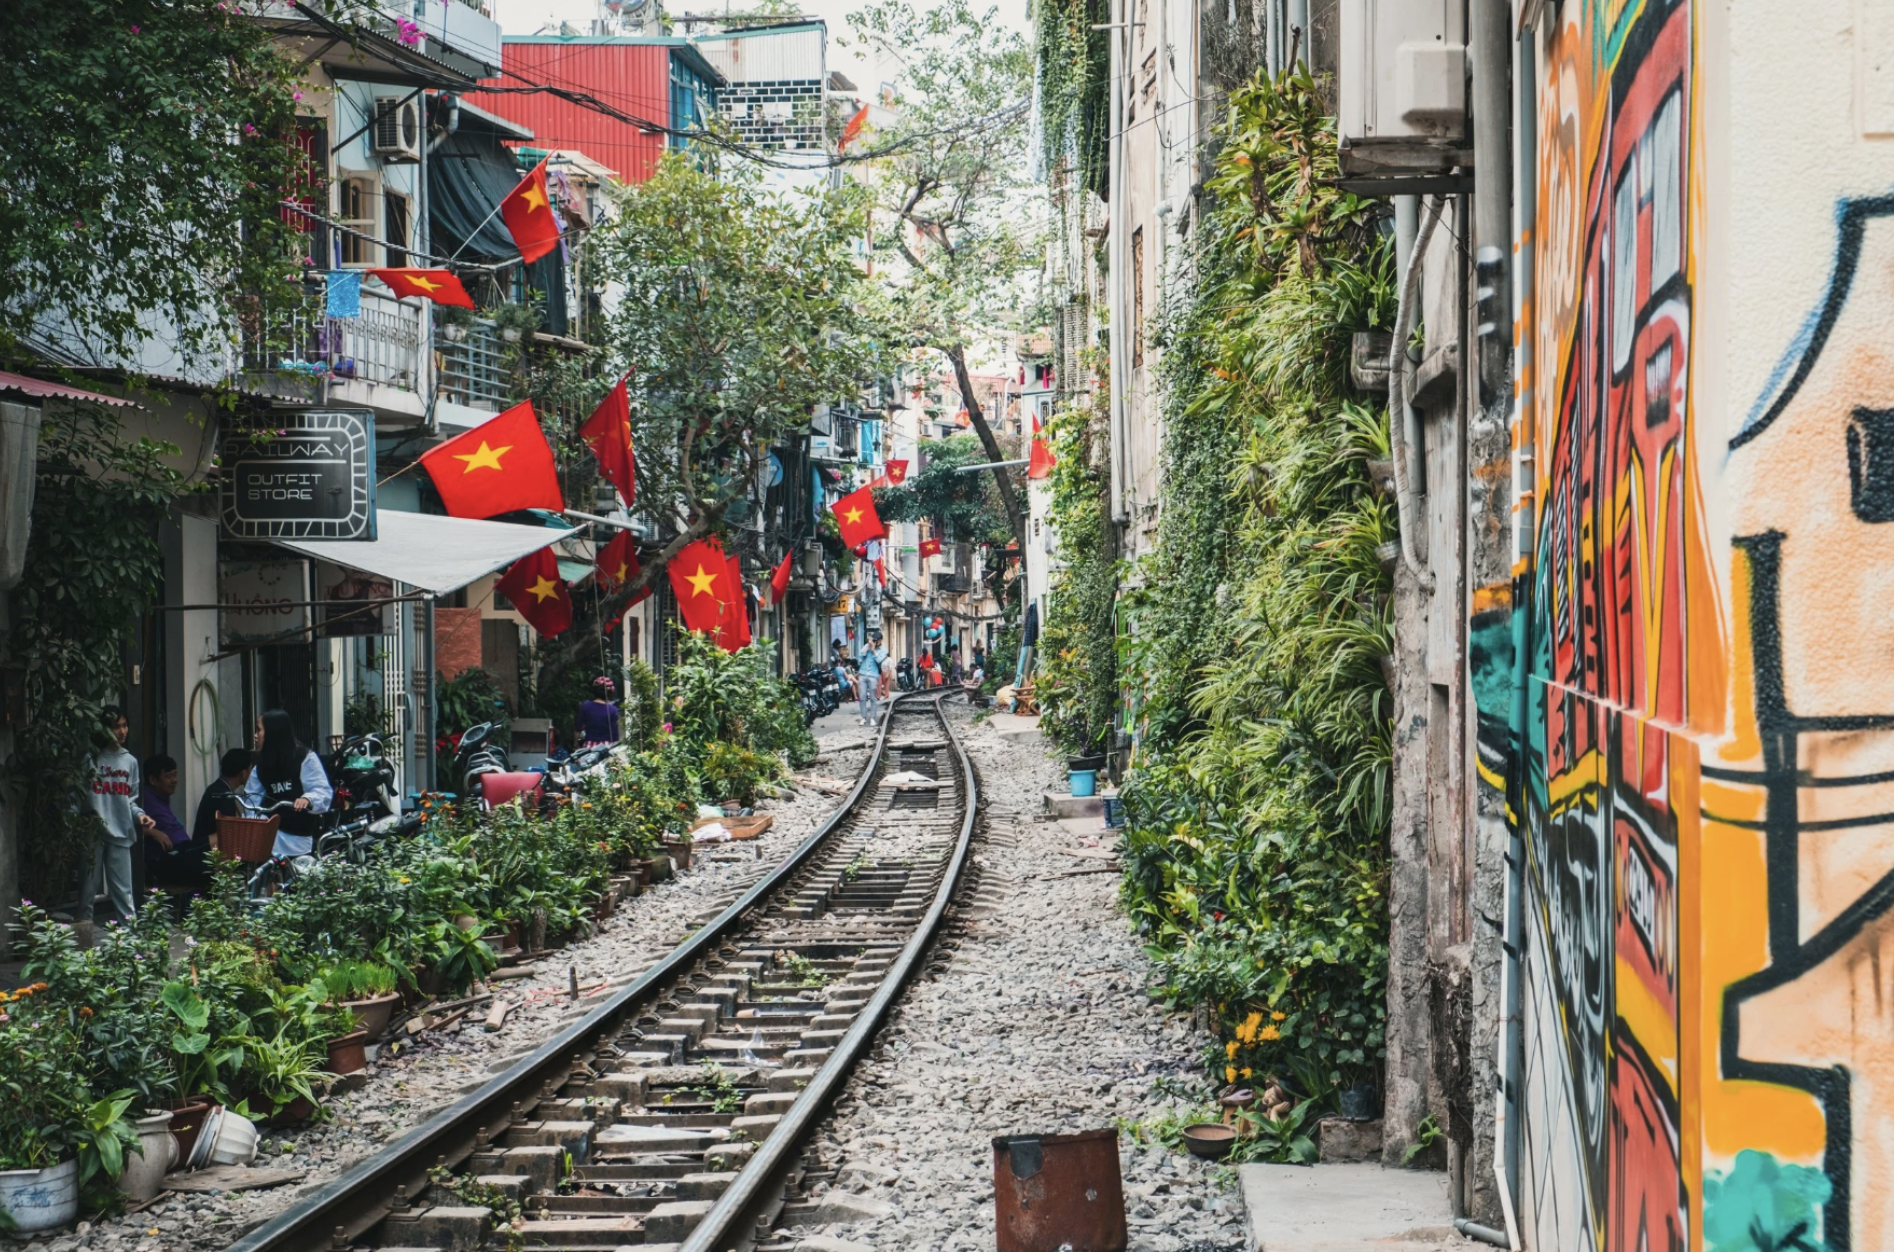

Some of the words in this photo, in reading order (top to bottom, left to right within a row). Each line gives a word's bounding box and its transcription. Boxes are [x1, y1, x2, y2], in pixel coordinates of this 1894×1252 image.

[223, 443, 349, 457] RAILWAY
[247, 473, 323, 486] OUTFIT
[247, 488, 313, 501] STORE
